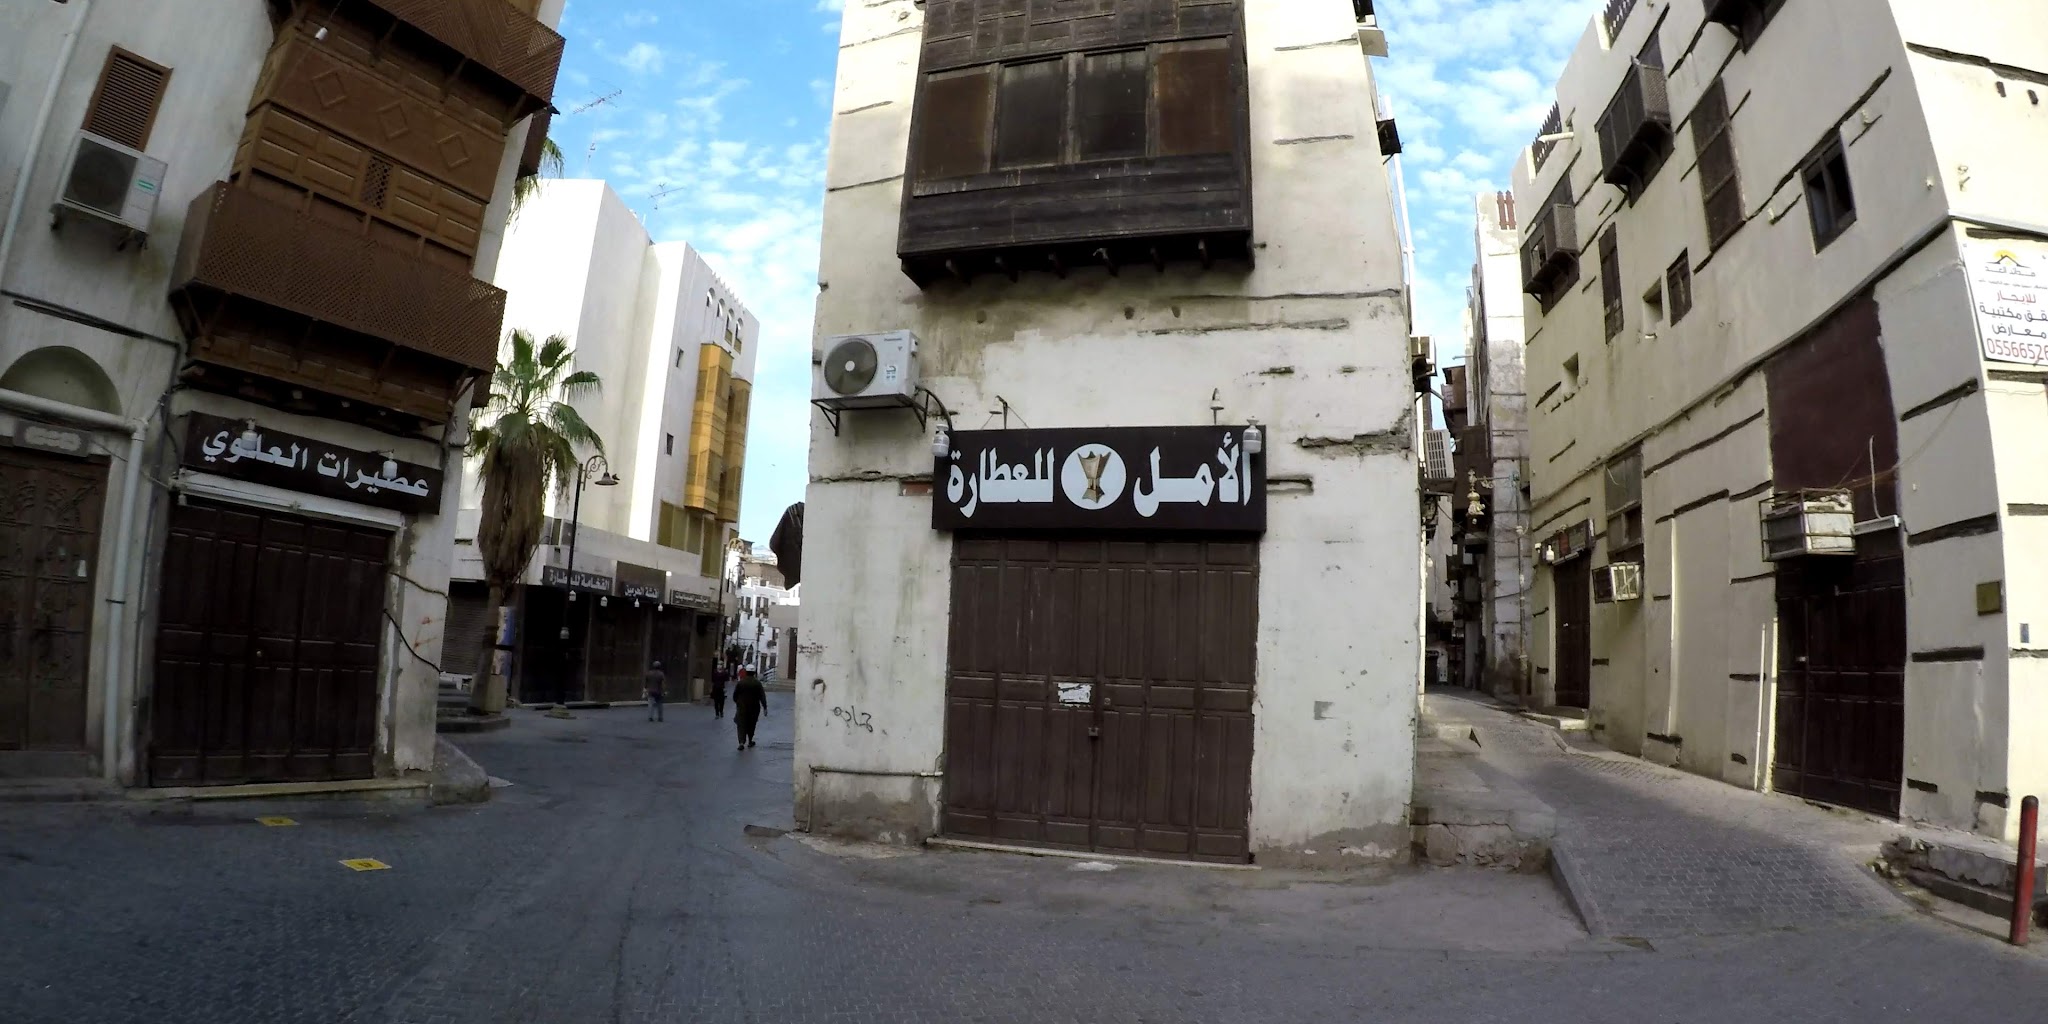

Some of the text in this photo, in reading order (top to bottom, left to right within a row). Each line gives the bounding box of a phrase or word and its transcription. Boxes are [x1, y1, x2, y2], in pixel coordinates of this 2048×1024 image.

[1979, 302, 2048, 323] قق مكتبية
[1991, 322, 2047, 339] معارض
[202, 430, 309, 471] العلوي
[947, 431, 1252, 518] الأمل للعطارة
[549, 569, 580, 586] للطارة
